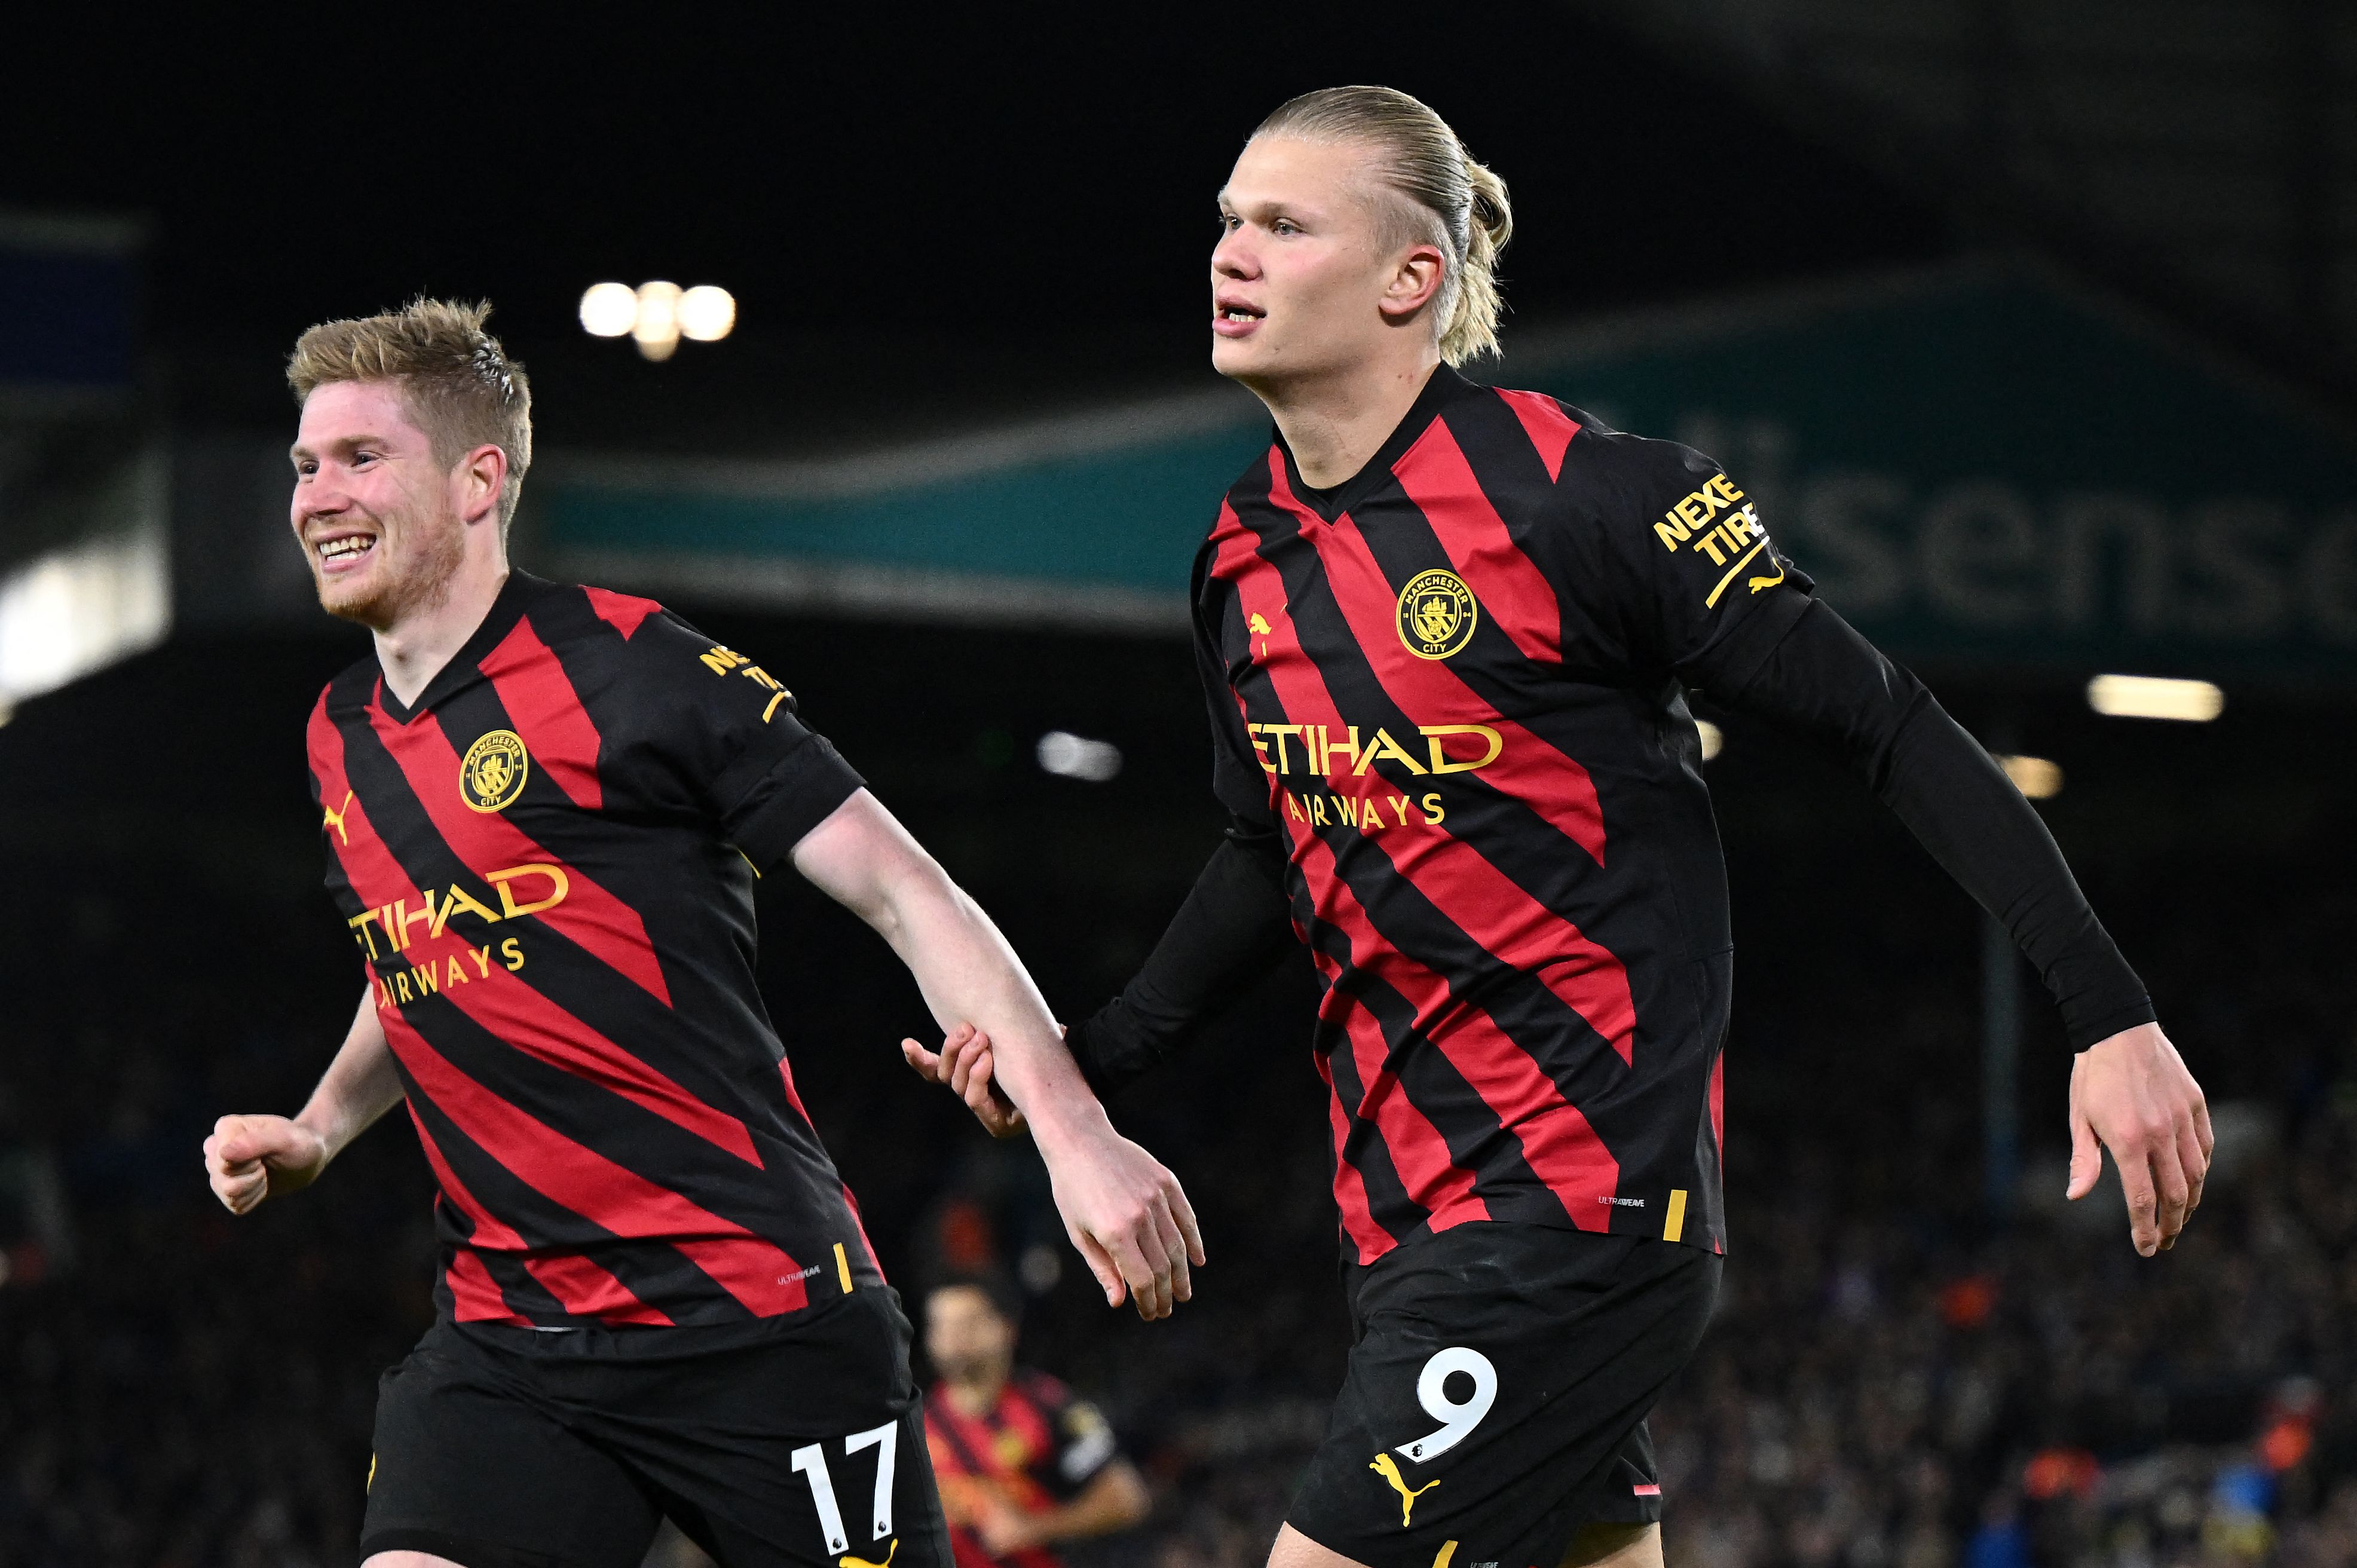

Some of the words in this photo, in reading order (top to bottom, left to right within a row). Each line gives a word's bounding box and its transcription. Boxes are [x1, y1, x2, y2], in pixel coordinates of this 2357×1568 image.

[1693, 502, 1765, 566] TIRE
[1405, 576, 1468, 605] MANCHESTER
[1423, 644, 1447, 653] CITY
[469, 736, 521, 767] MANCHESTER
[480, 795, 501, 806] CITY
[1287, 793, 1445, 829] AIRWAYS
[348, 863, 569, 961] TIHAD
[379, 938, 525, 1010] AIRWAYS
[1392, 1346, 1498, 1465] 9
[791, 1419, 898, 1556] 17
